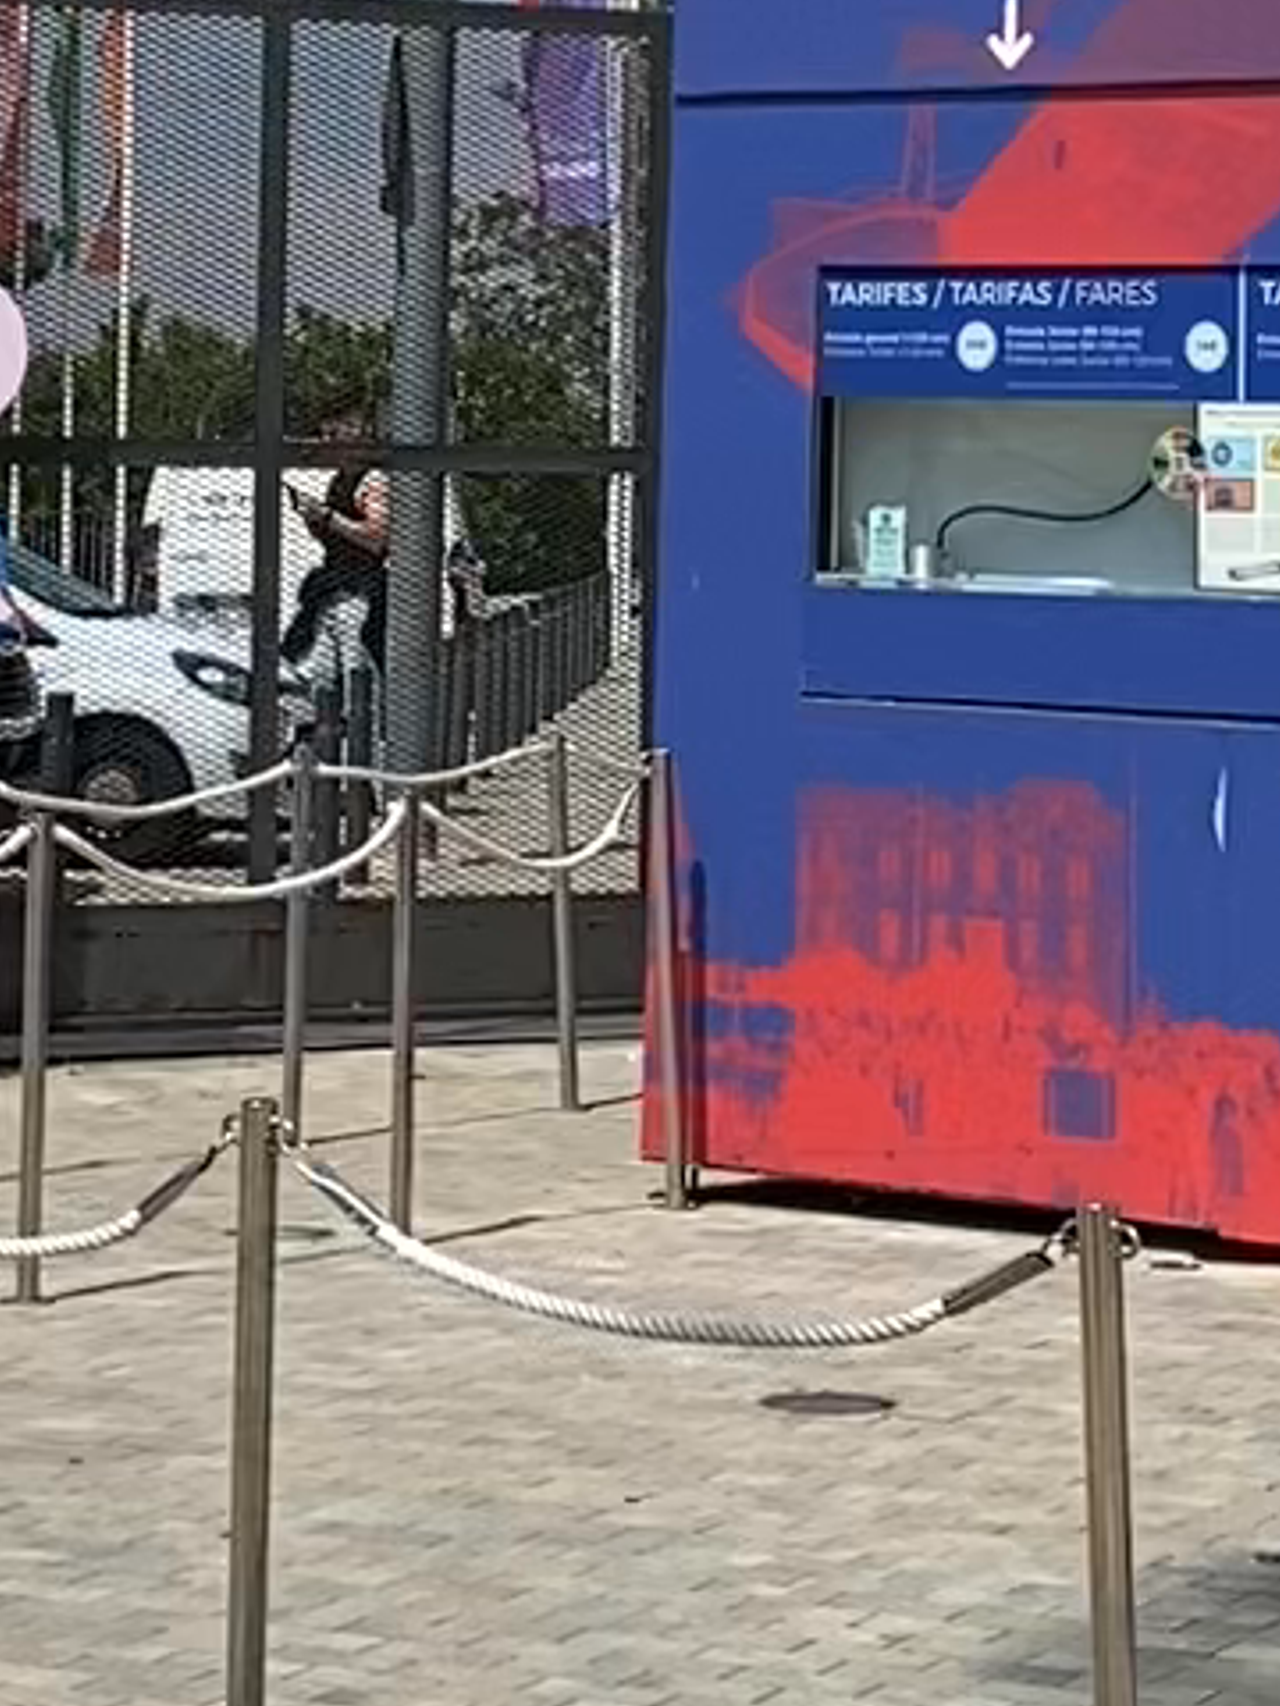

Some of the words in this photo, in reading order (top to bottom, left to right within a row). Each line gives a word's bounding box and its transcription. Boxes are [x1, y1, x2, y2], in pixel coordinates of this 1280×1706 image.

[826, 281, 928, 306] TARIFES
[949, 280, 1052, 305] TARIFAS
[1076, 280, 1157, 306] FARES
